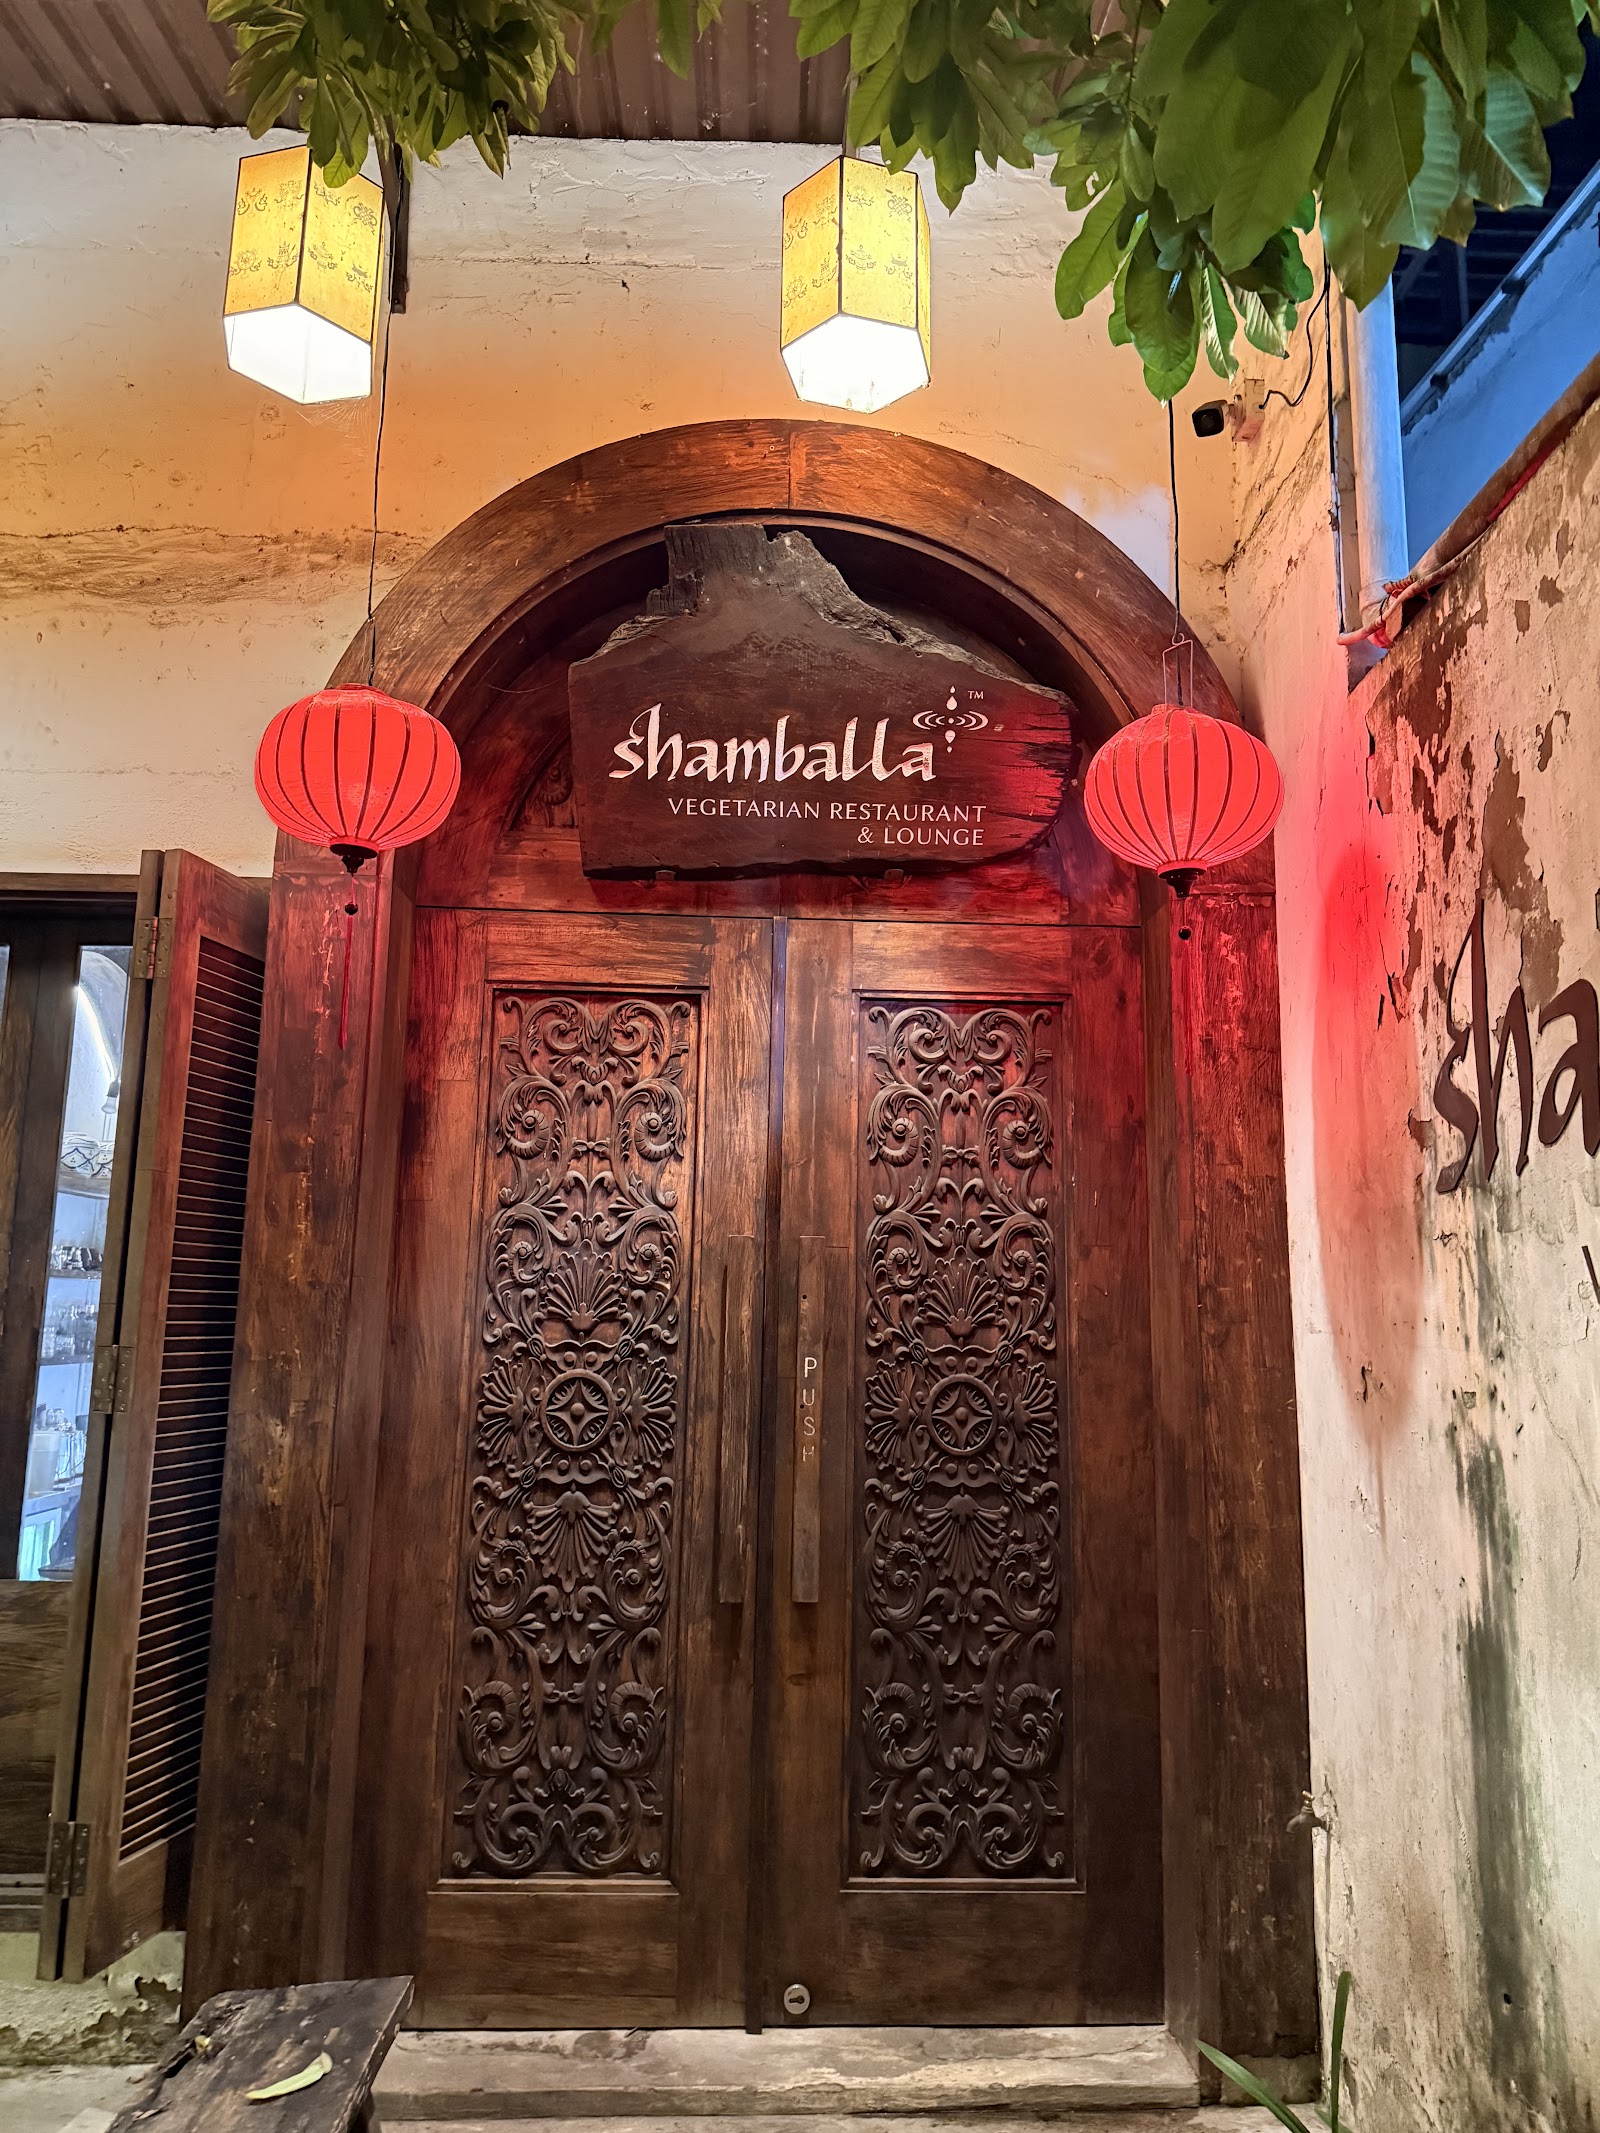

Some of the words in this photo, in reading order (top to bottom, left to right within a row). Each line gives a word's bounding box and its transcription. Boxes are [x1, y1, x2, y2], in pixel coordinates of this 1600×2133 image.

[609, 703, 936, 782] shamballa
[668, 797, 820, 818] VEGETARIAN
[830, 803, 987, 822] RESTAURANT
[857, 826, 874, 844] &
[884, 827, 984, 845] LOUNGE
[803, 1356, 818, 1462] PUSH
